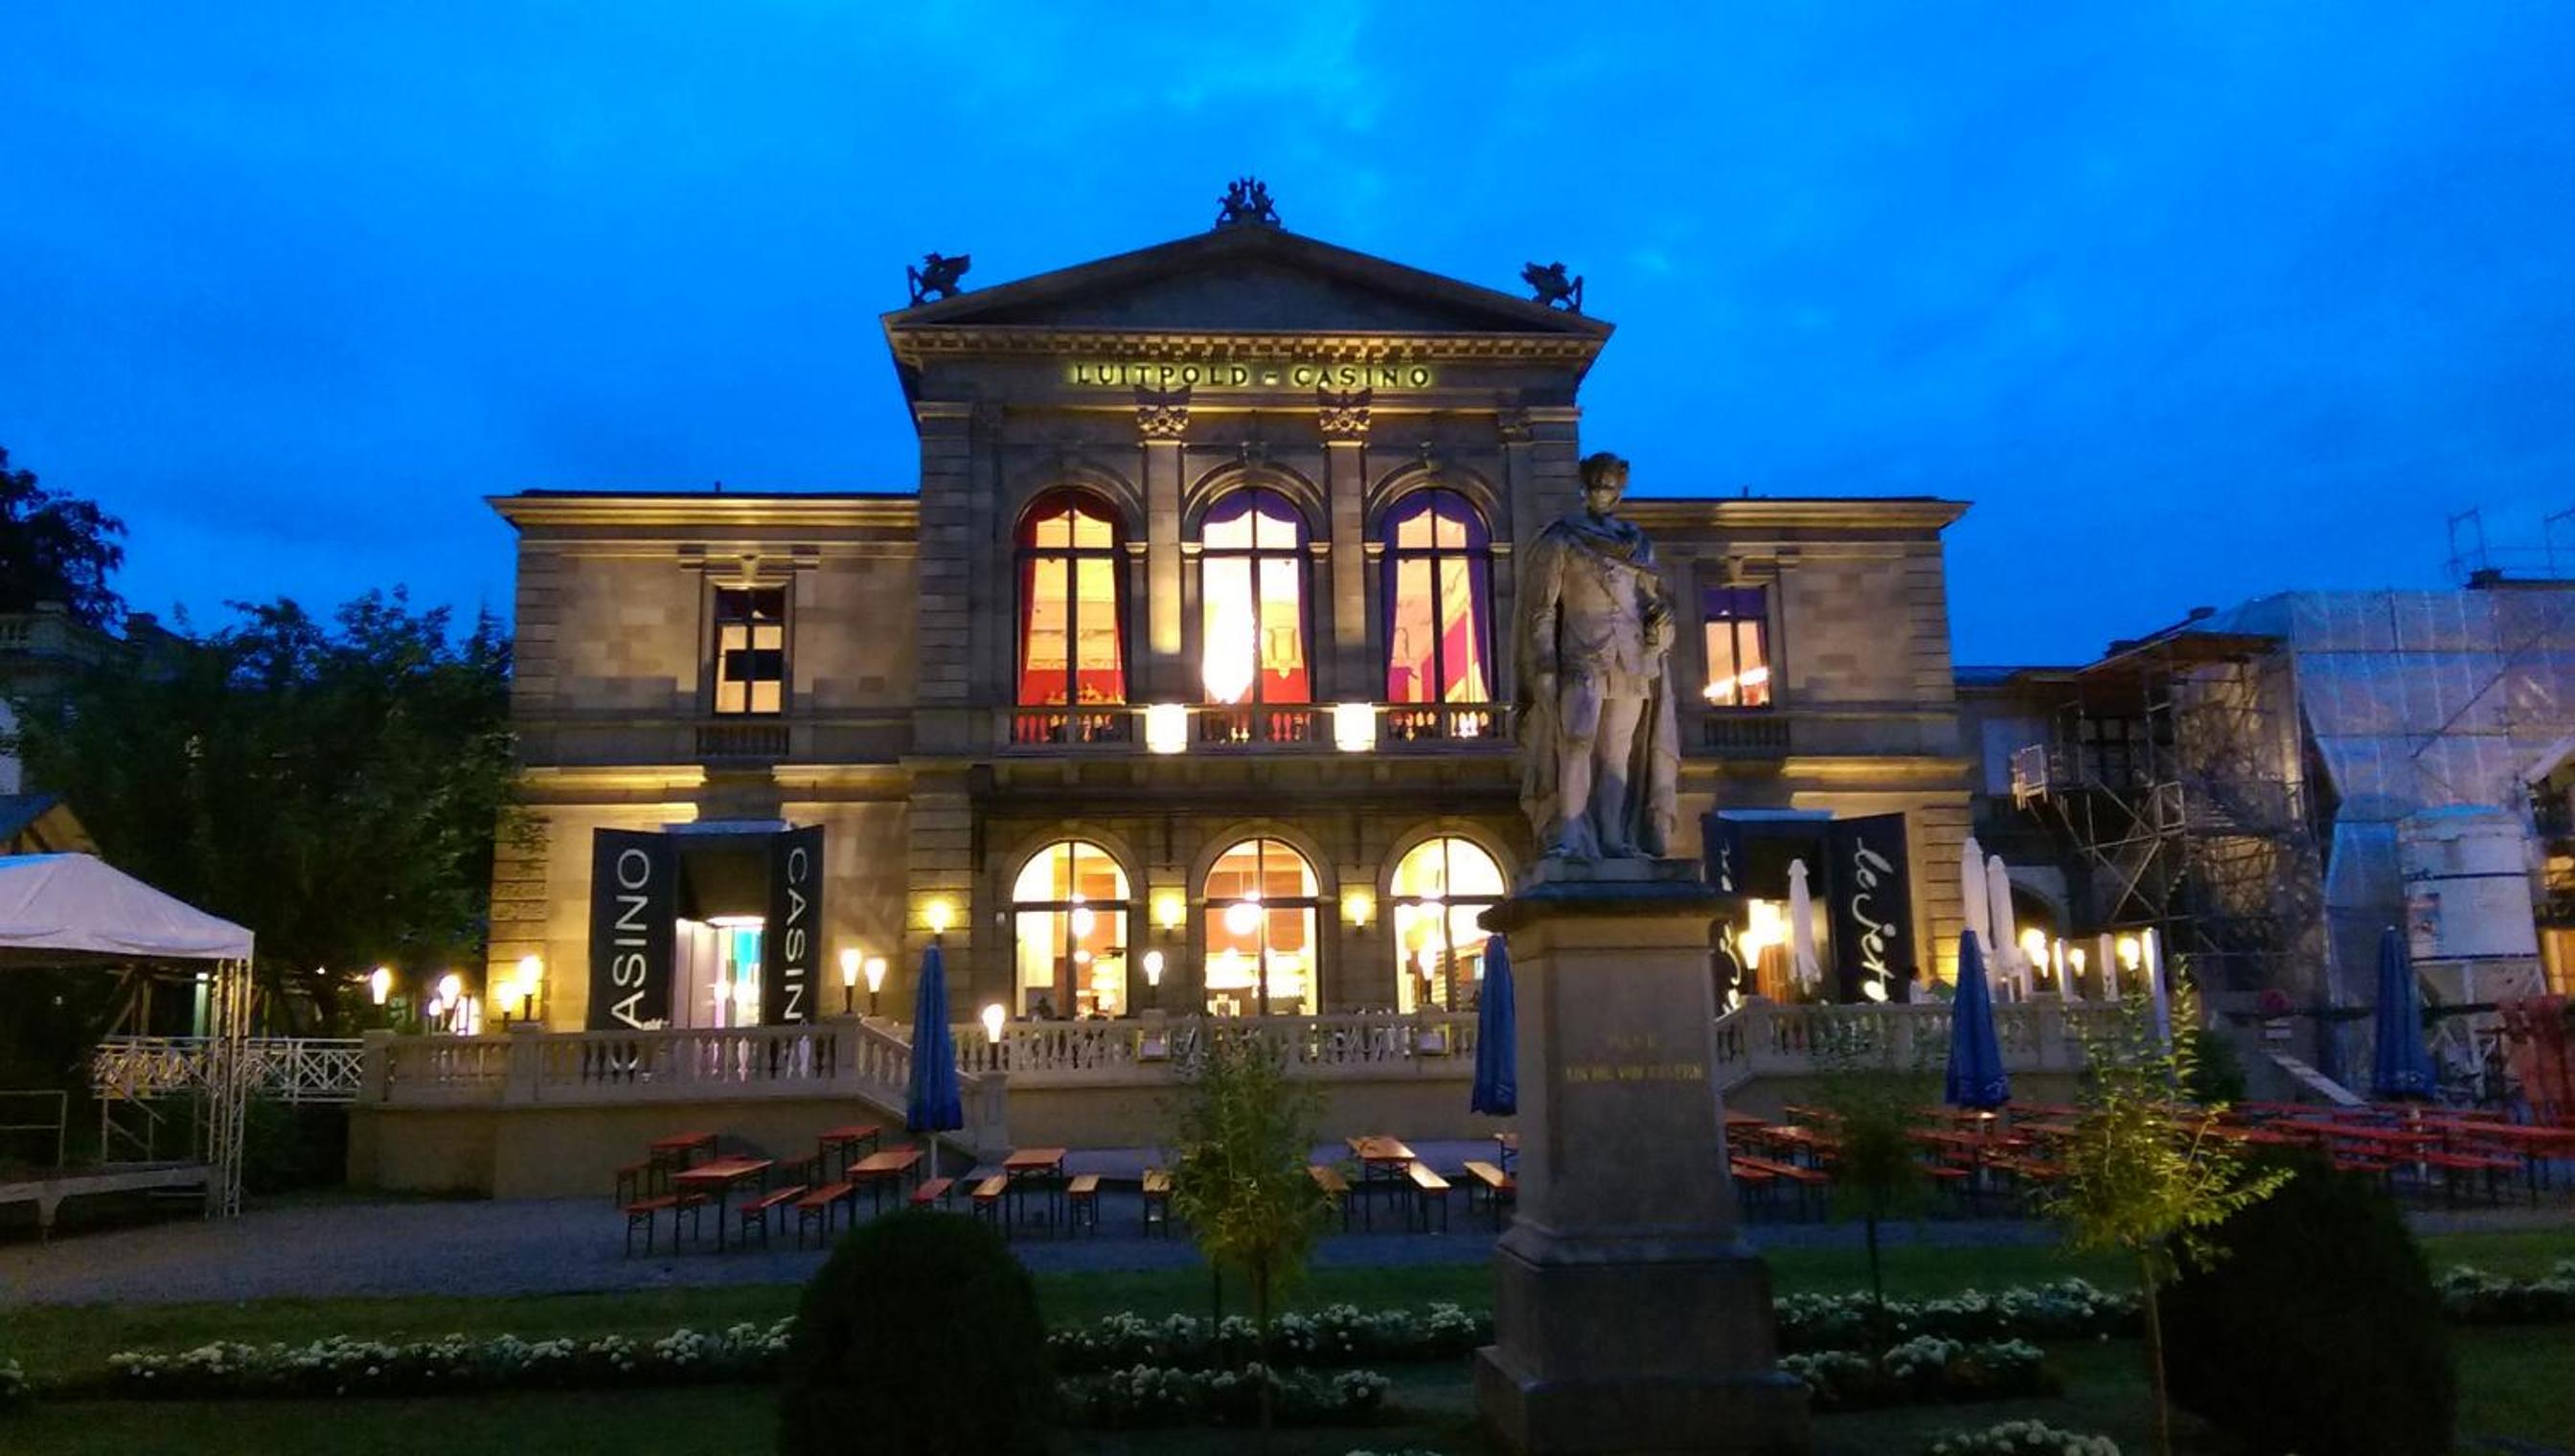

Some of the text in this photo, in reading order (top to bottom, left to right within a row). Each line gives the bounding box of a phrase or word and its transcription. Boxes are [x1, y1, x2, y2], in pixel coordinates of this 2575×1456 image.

[1076, 364, 1248, 385] LUITPOLD
[1293, 364, 1429, 385] CASINO
[610, 848, 652, 1070] ASINO
[784, 847, 809, 1019] CASIN
[1852, 893, 1896, 1002] jeto
